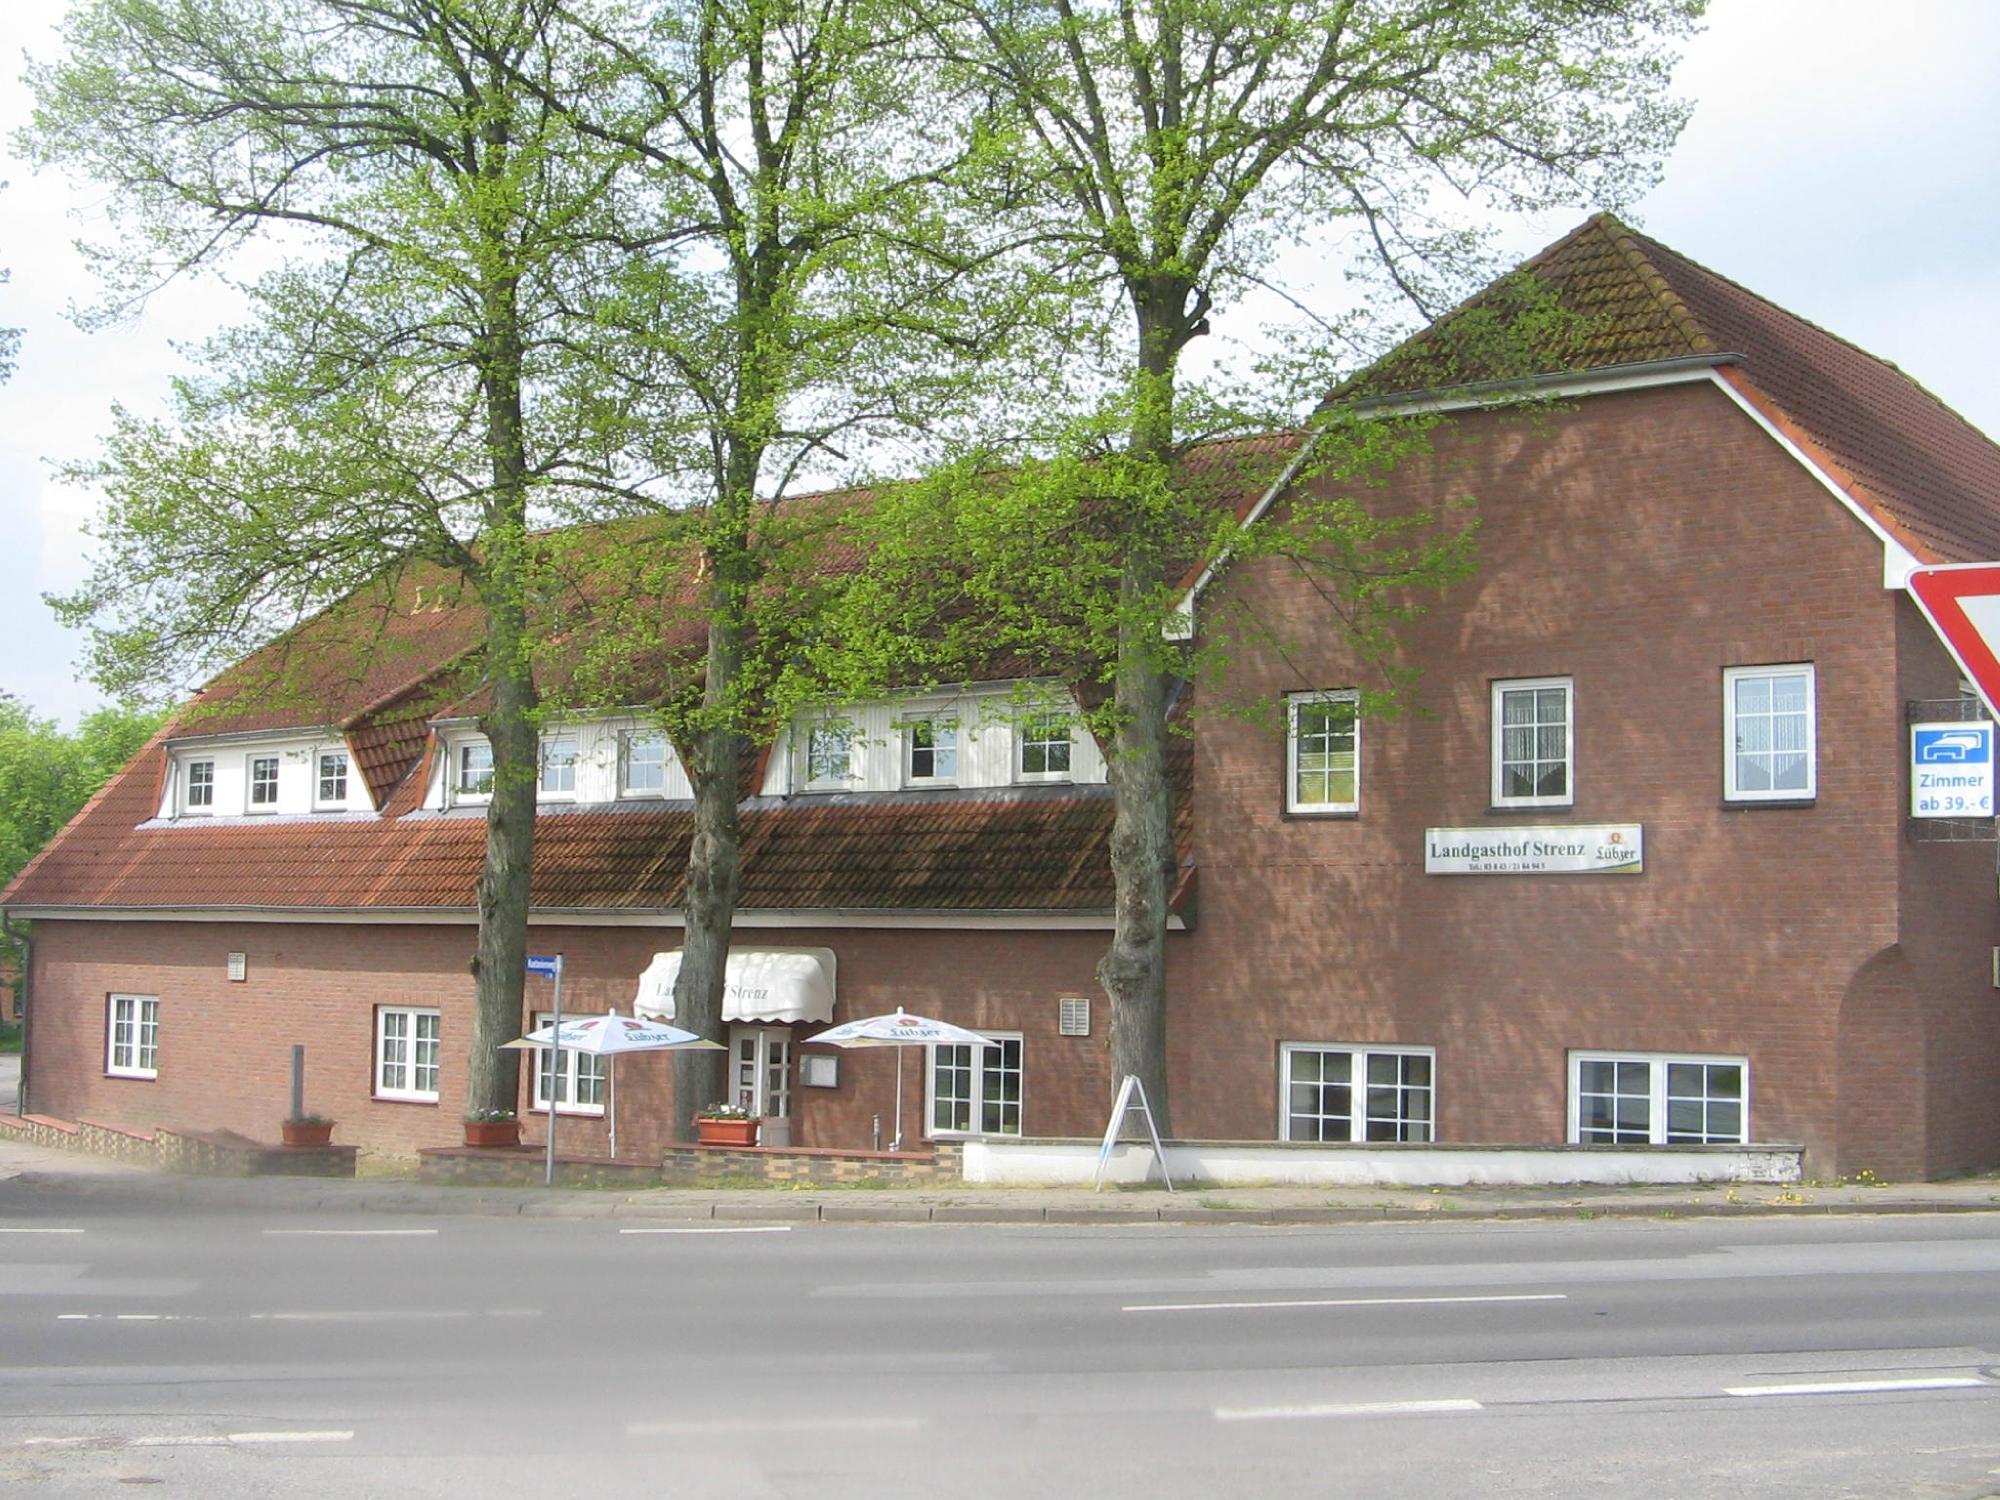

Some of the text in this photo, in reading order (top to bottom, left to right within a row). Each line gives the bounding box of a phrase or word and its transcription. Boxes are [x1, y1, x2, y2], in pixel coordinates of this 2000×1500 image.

[1920, 774, 1984, 787] Zimmer
[1919, 796, 1940, 811] ab
[1431, 842, 1585, 860] Landgasthof Strenz
[1596, 846, 1636, 861] Lübzer
[728, 984, 769, 1000] Strenz
